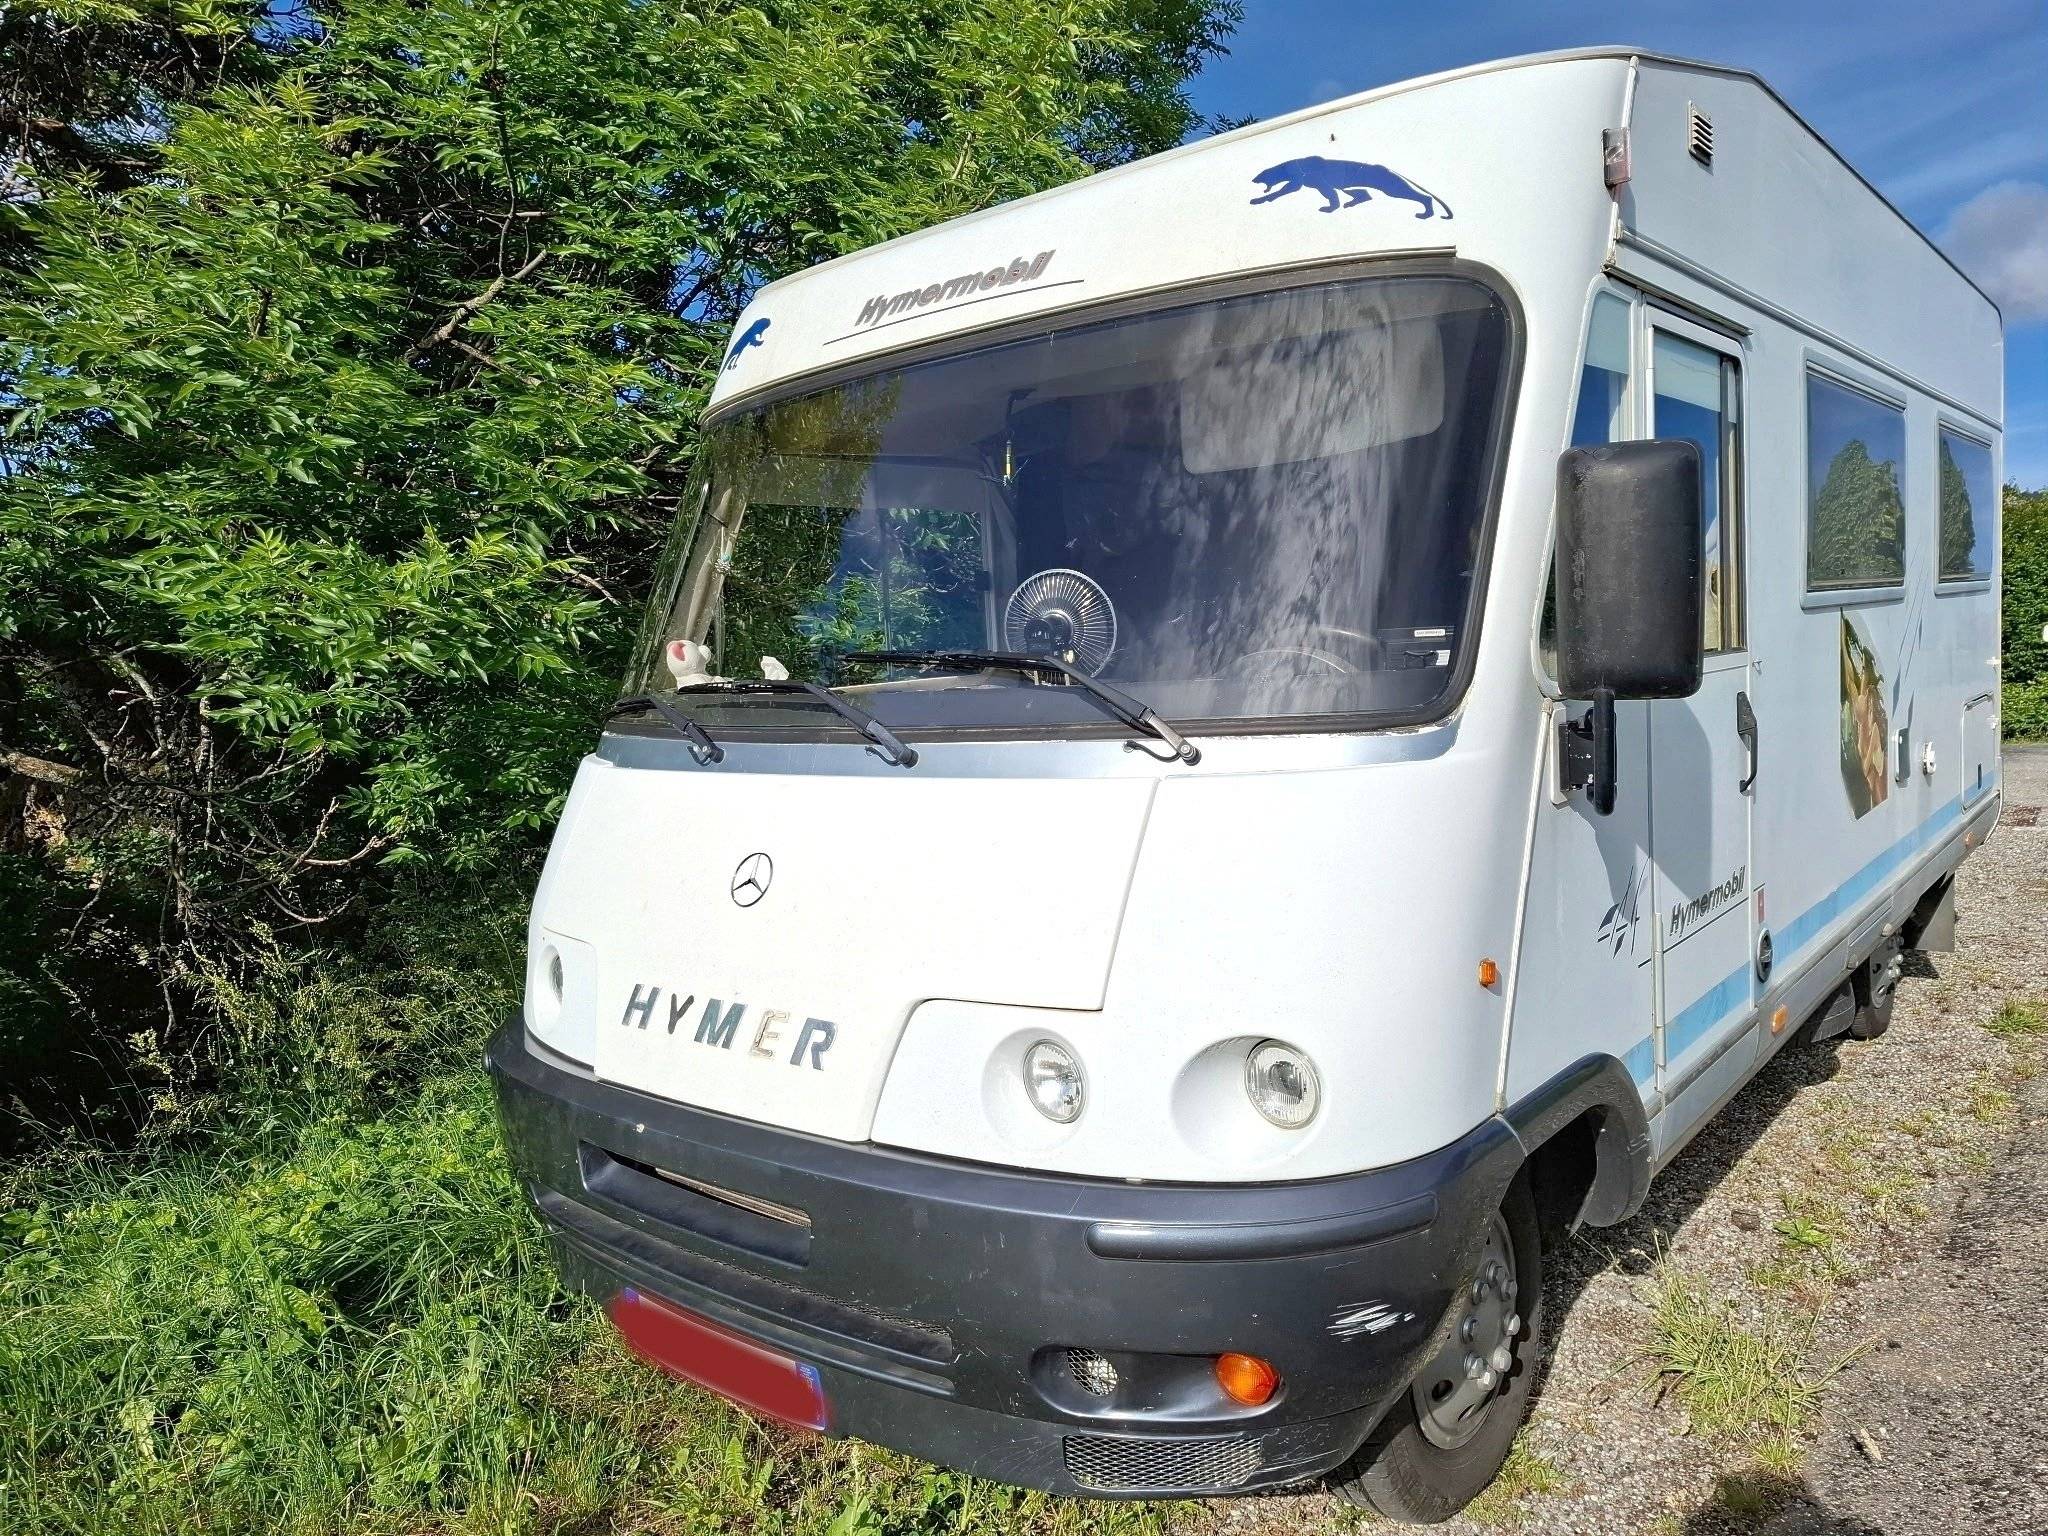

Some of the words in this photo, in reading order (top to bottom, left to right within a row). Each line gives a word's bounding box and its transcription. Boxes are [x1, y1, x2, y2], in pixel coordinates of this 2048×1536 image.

[854, 249, 1057, 326] Hymermobil
[1669, 865, 1747, 938] Hymermobil
[621, 983, 839, 1071] HYMER
